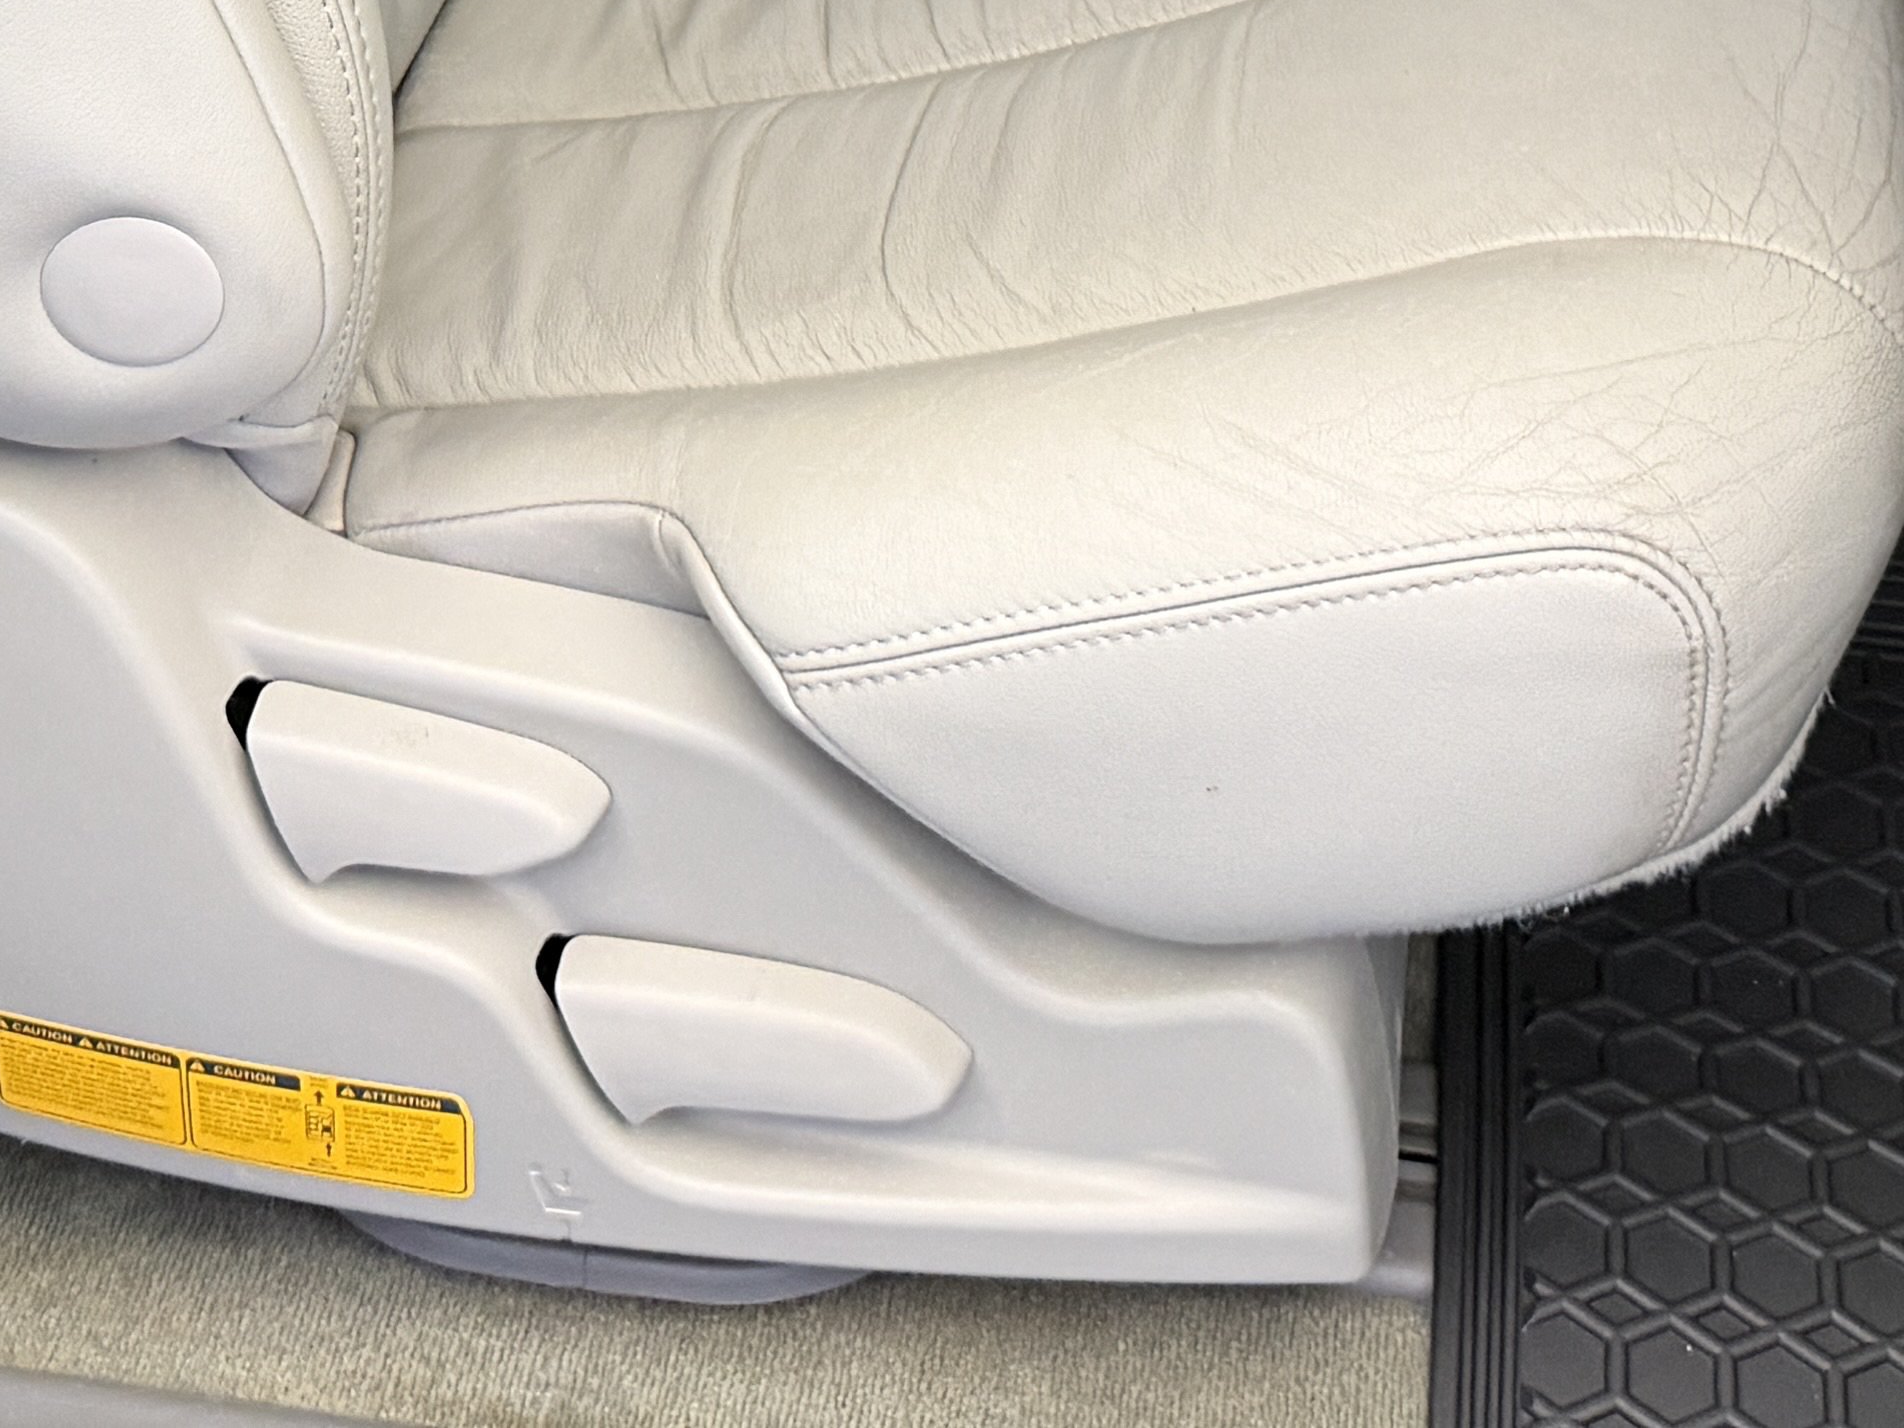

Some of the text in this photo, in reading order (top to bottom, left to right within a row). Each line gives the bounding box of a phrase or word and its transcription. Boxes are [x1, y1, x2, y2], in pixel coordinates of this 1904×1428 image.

[12, 1021, 173, 1066] CAUTION ATTENTION
[213, 1064, 442, 1110] CAUTION ATTENTION
